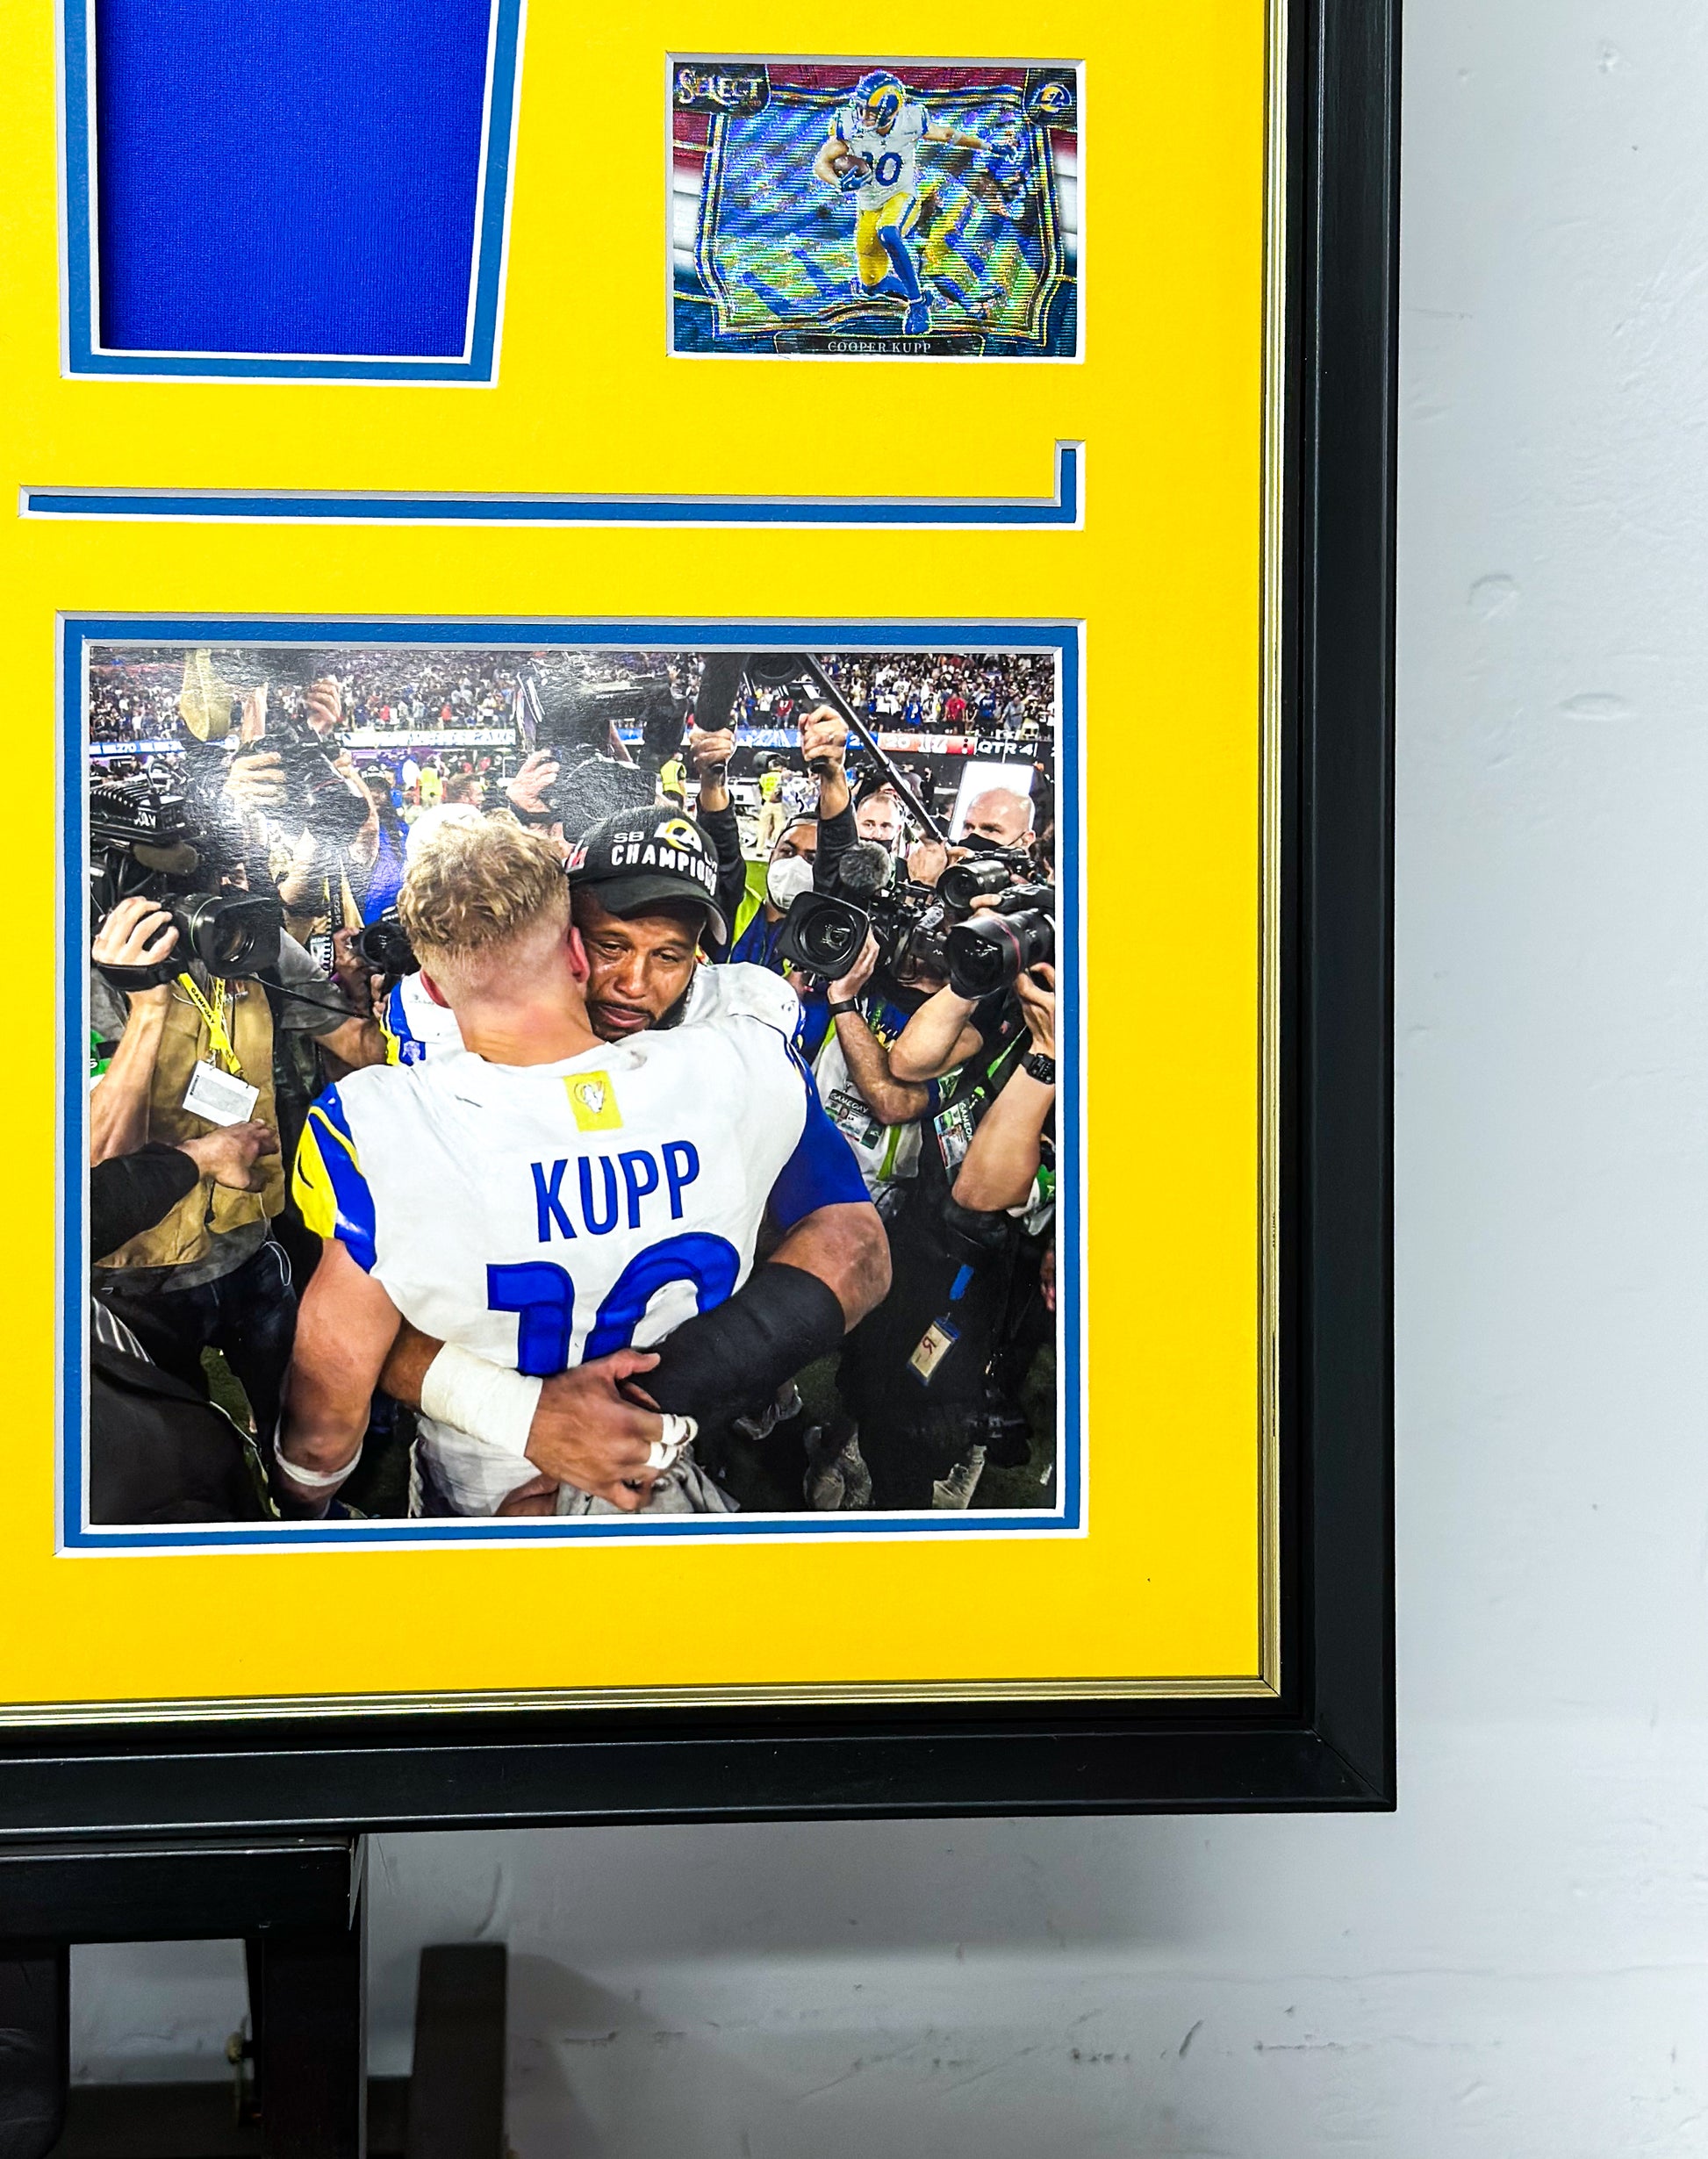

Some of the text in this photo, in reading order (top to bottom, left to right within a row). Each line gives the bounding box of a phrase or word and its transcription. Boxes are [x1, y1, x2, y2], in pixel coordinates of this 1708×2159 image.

[827, 341, 931, 354] COOPER KUPP
[978, 740, 1034, 756] QTR 4
[614, 831, 645, 843] SB
[530, 1140, 700, 1244] KUPP
